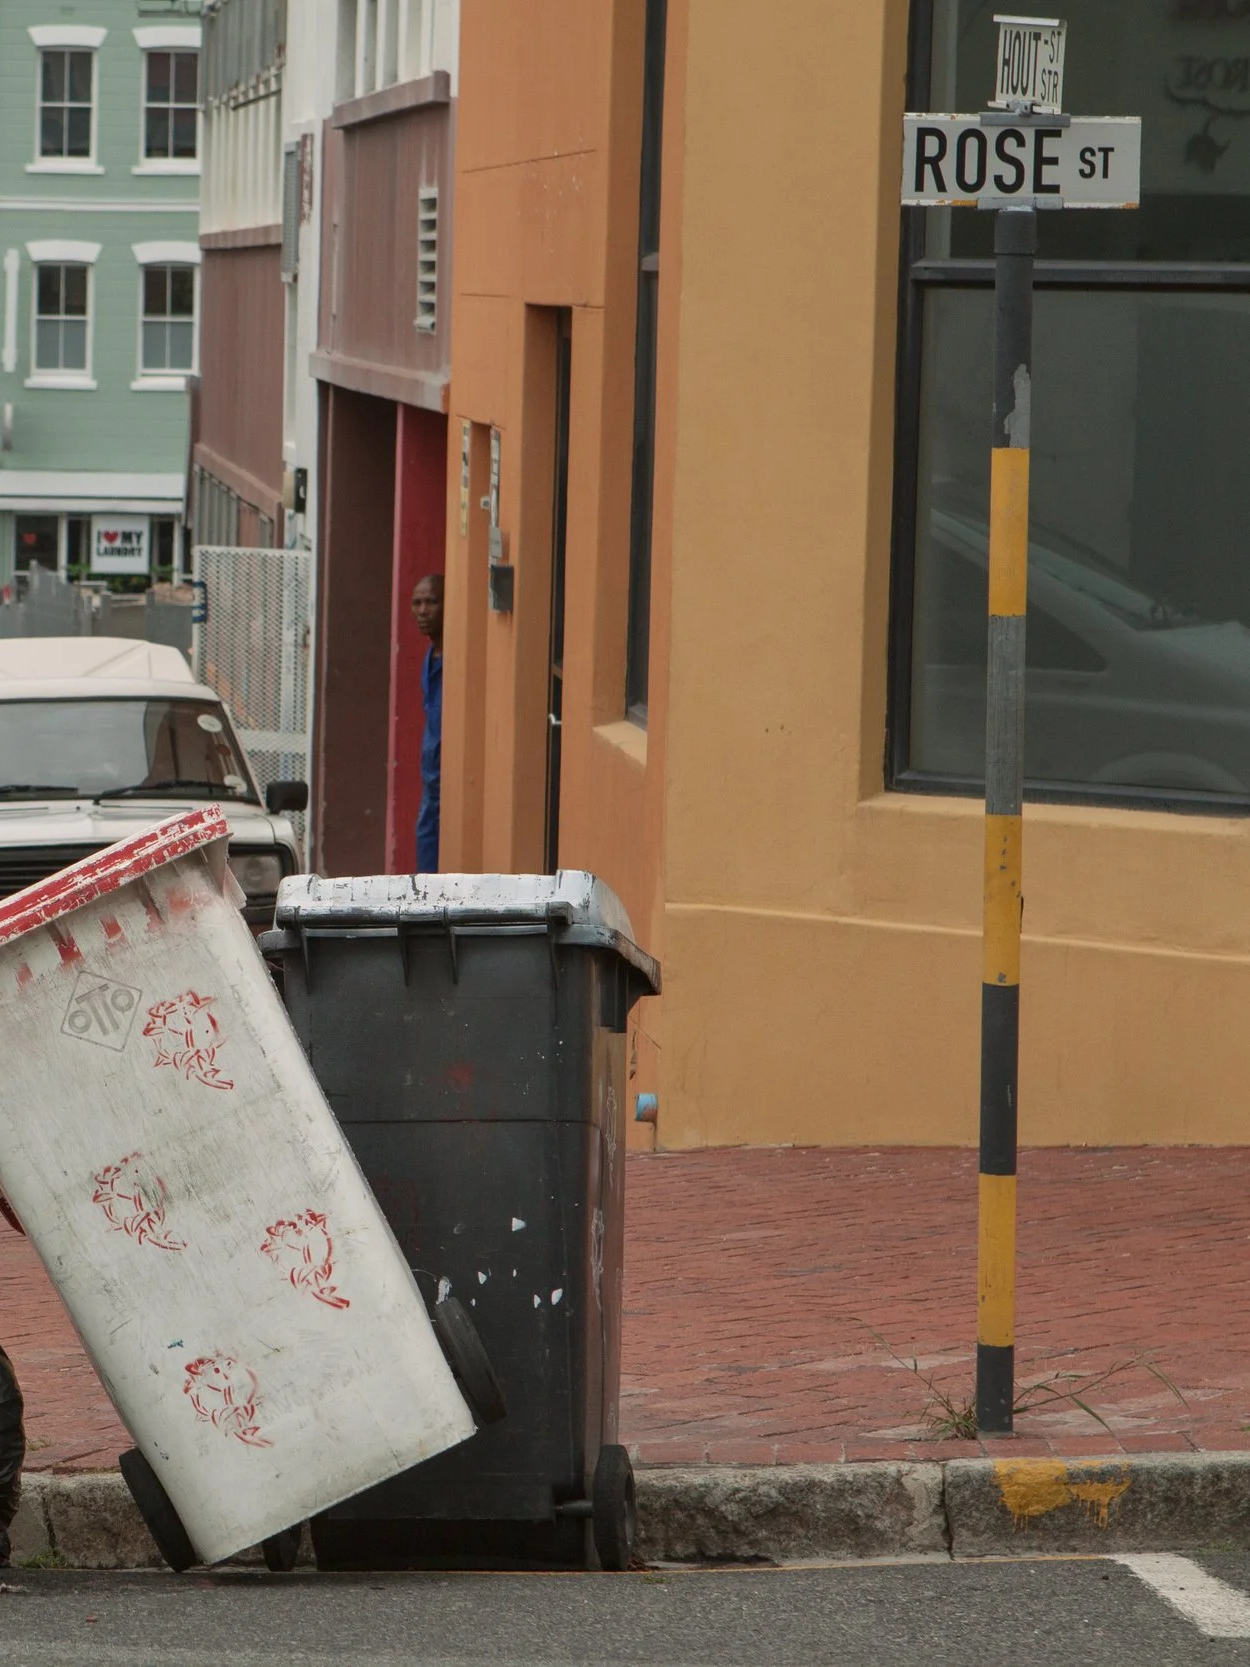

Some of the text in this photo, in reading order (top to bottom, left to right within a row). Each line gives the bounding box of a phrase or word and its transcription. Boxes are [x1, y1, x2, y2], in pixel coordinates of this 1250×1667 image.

[1000, 29, 1042, 97] HOUT
[1040, 67, 1059, 103] STR
[914, 127, 1115, 194] ROSE ST
[120, 530, 143, 544] MY
[68, 983, 135, 1037] OTTO
